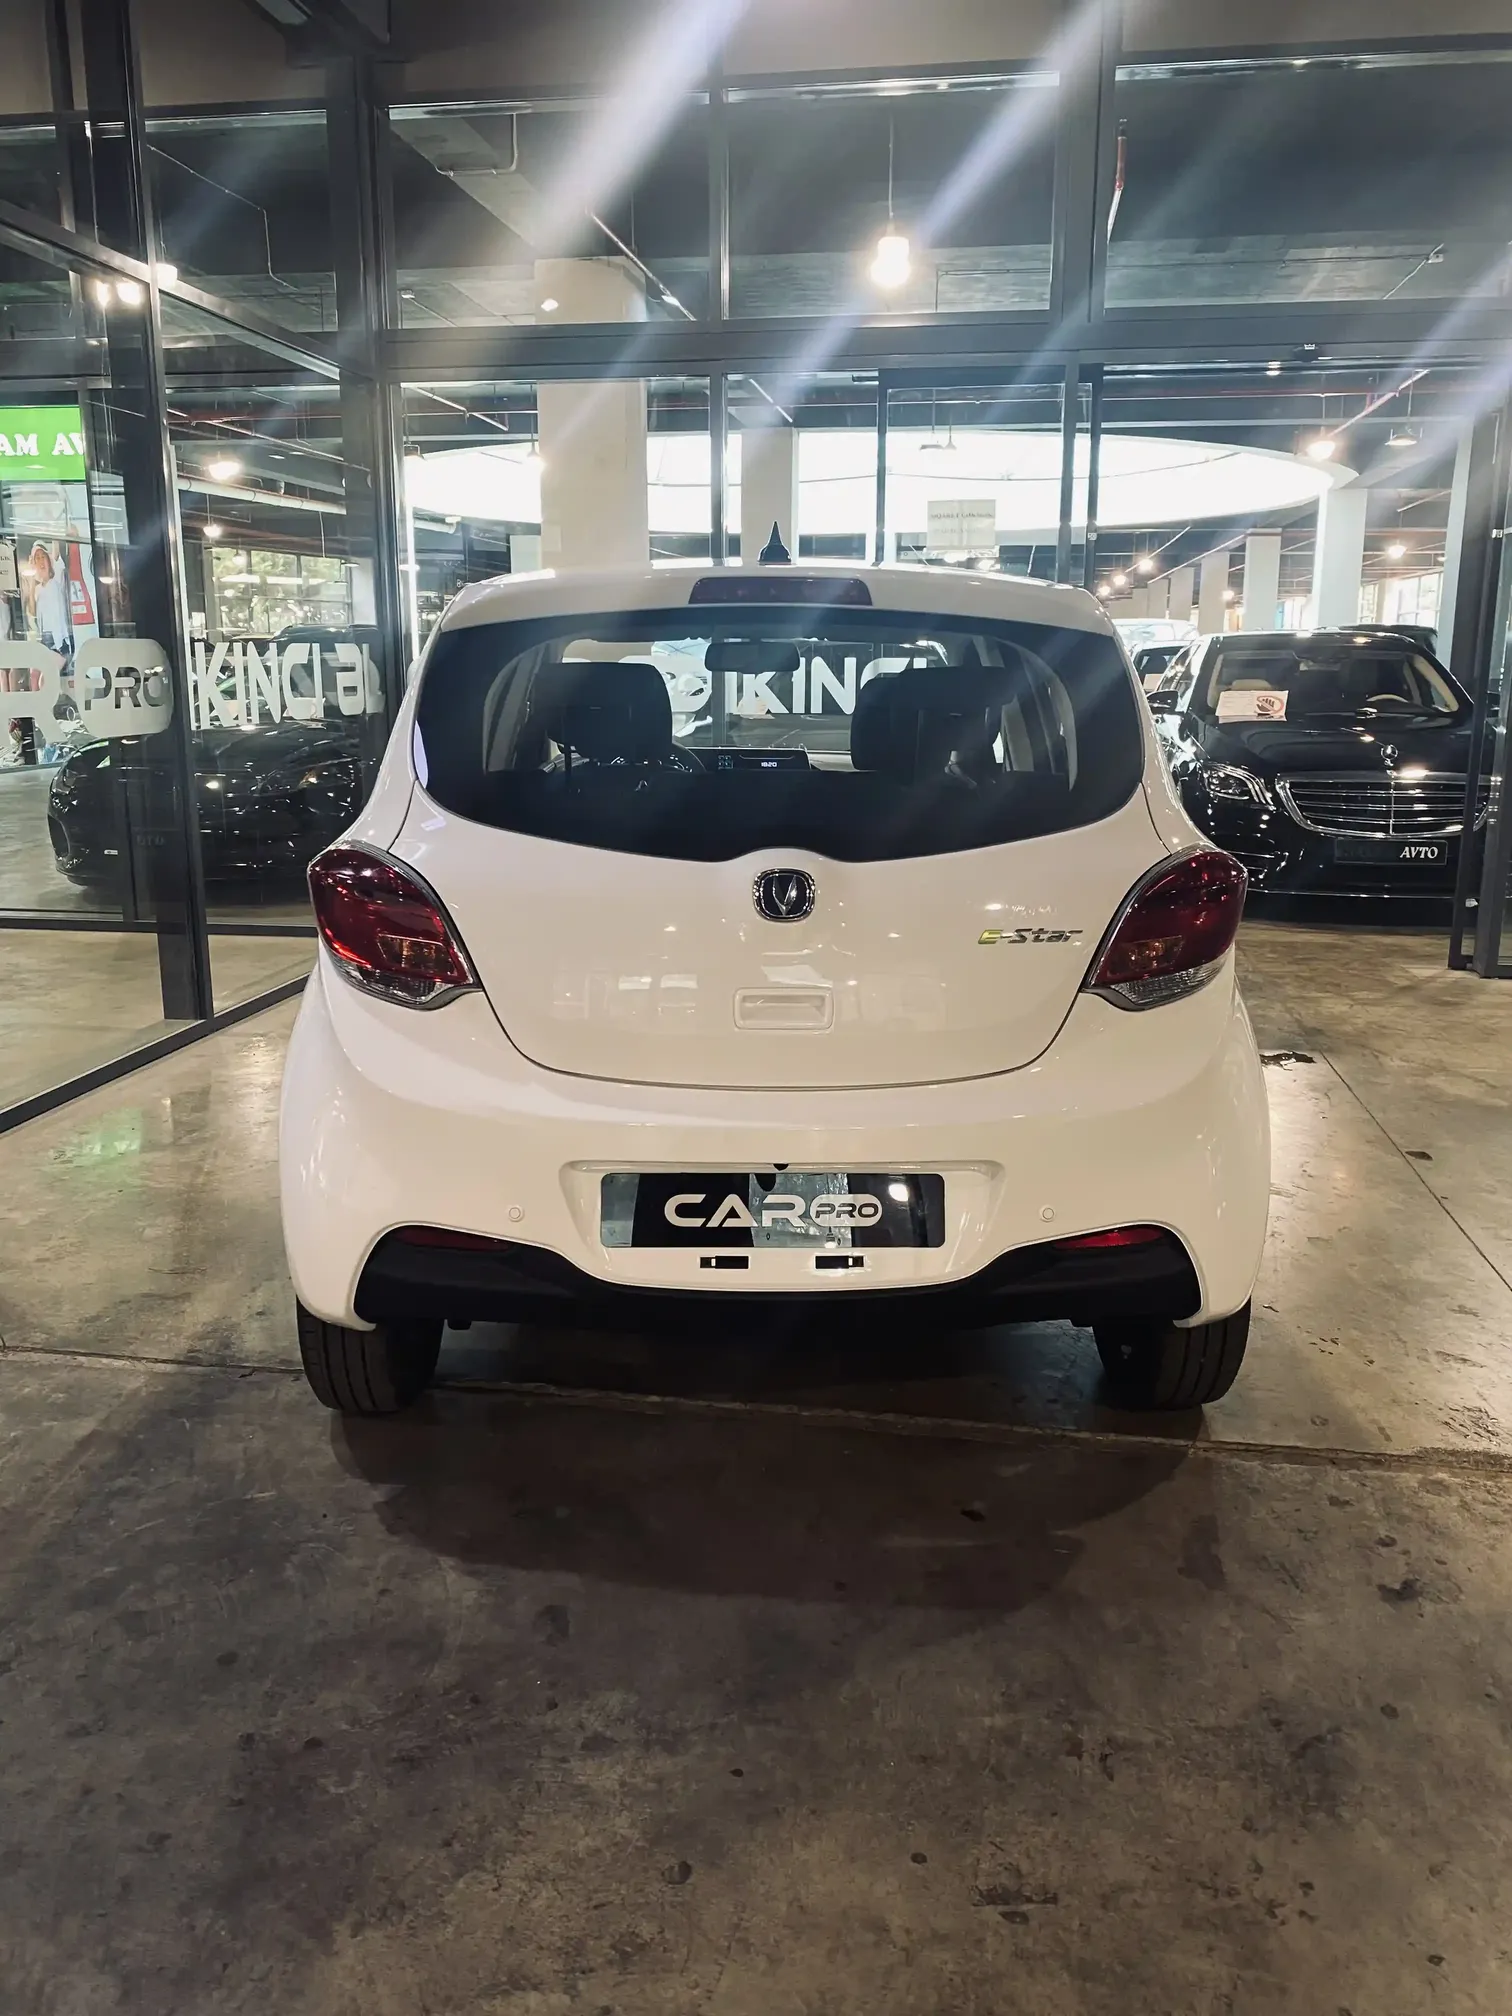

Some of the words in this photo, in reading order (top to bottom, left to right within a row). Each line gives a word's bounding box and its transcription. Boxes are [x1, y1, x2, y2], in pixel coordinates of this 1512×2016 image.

[1400, 847, 1439, 859] AVTO
[978, 928, 1083, 945] E-Star
[664, 1193, 806, 1228] CAR
[814, 1202, 879, 1219] PRO
